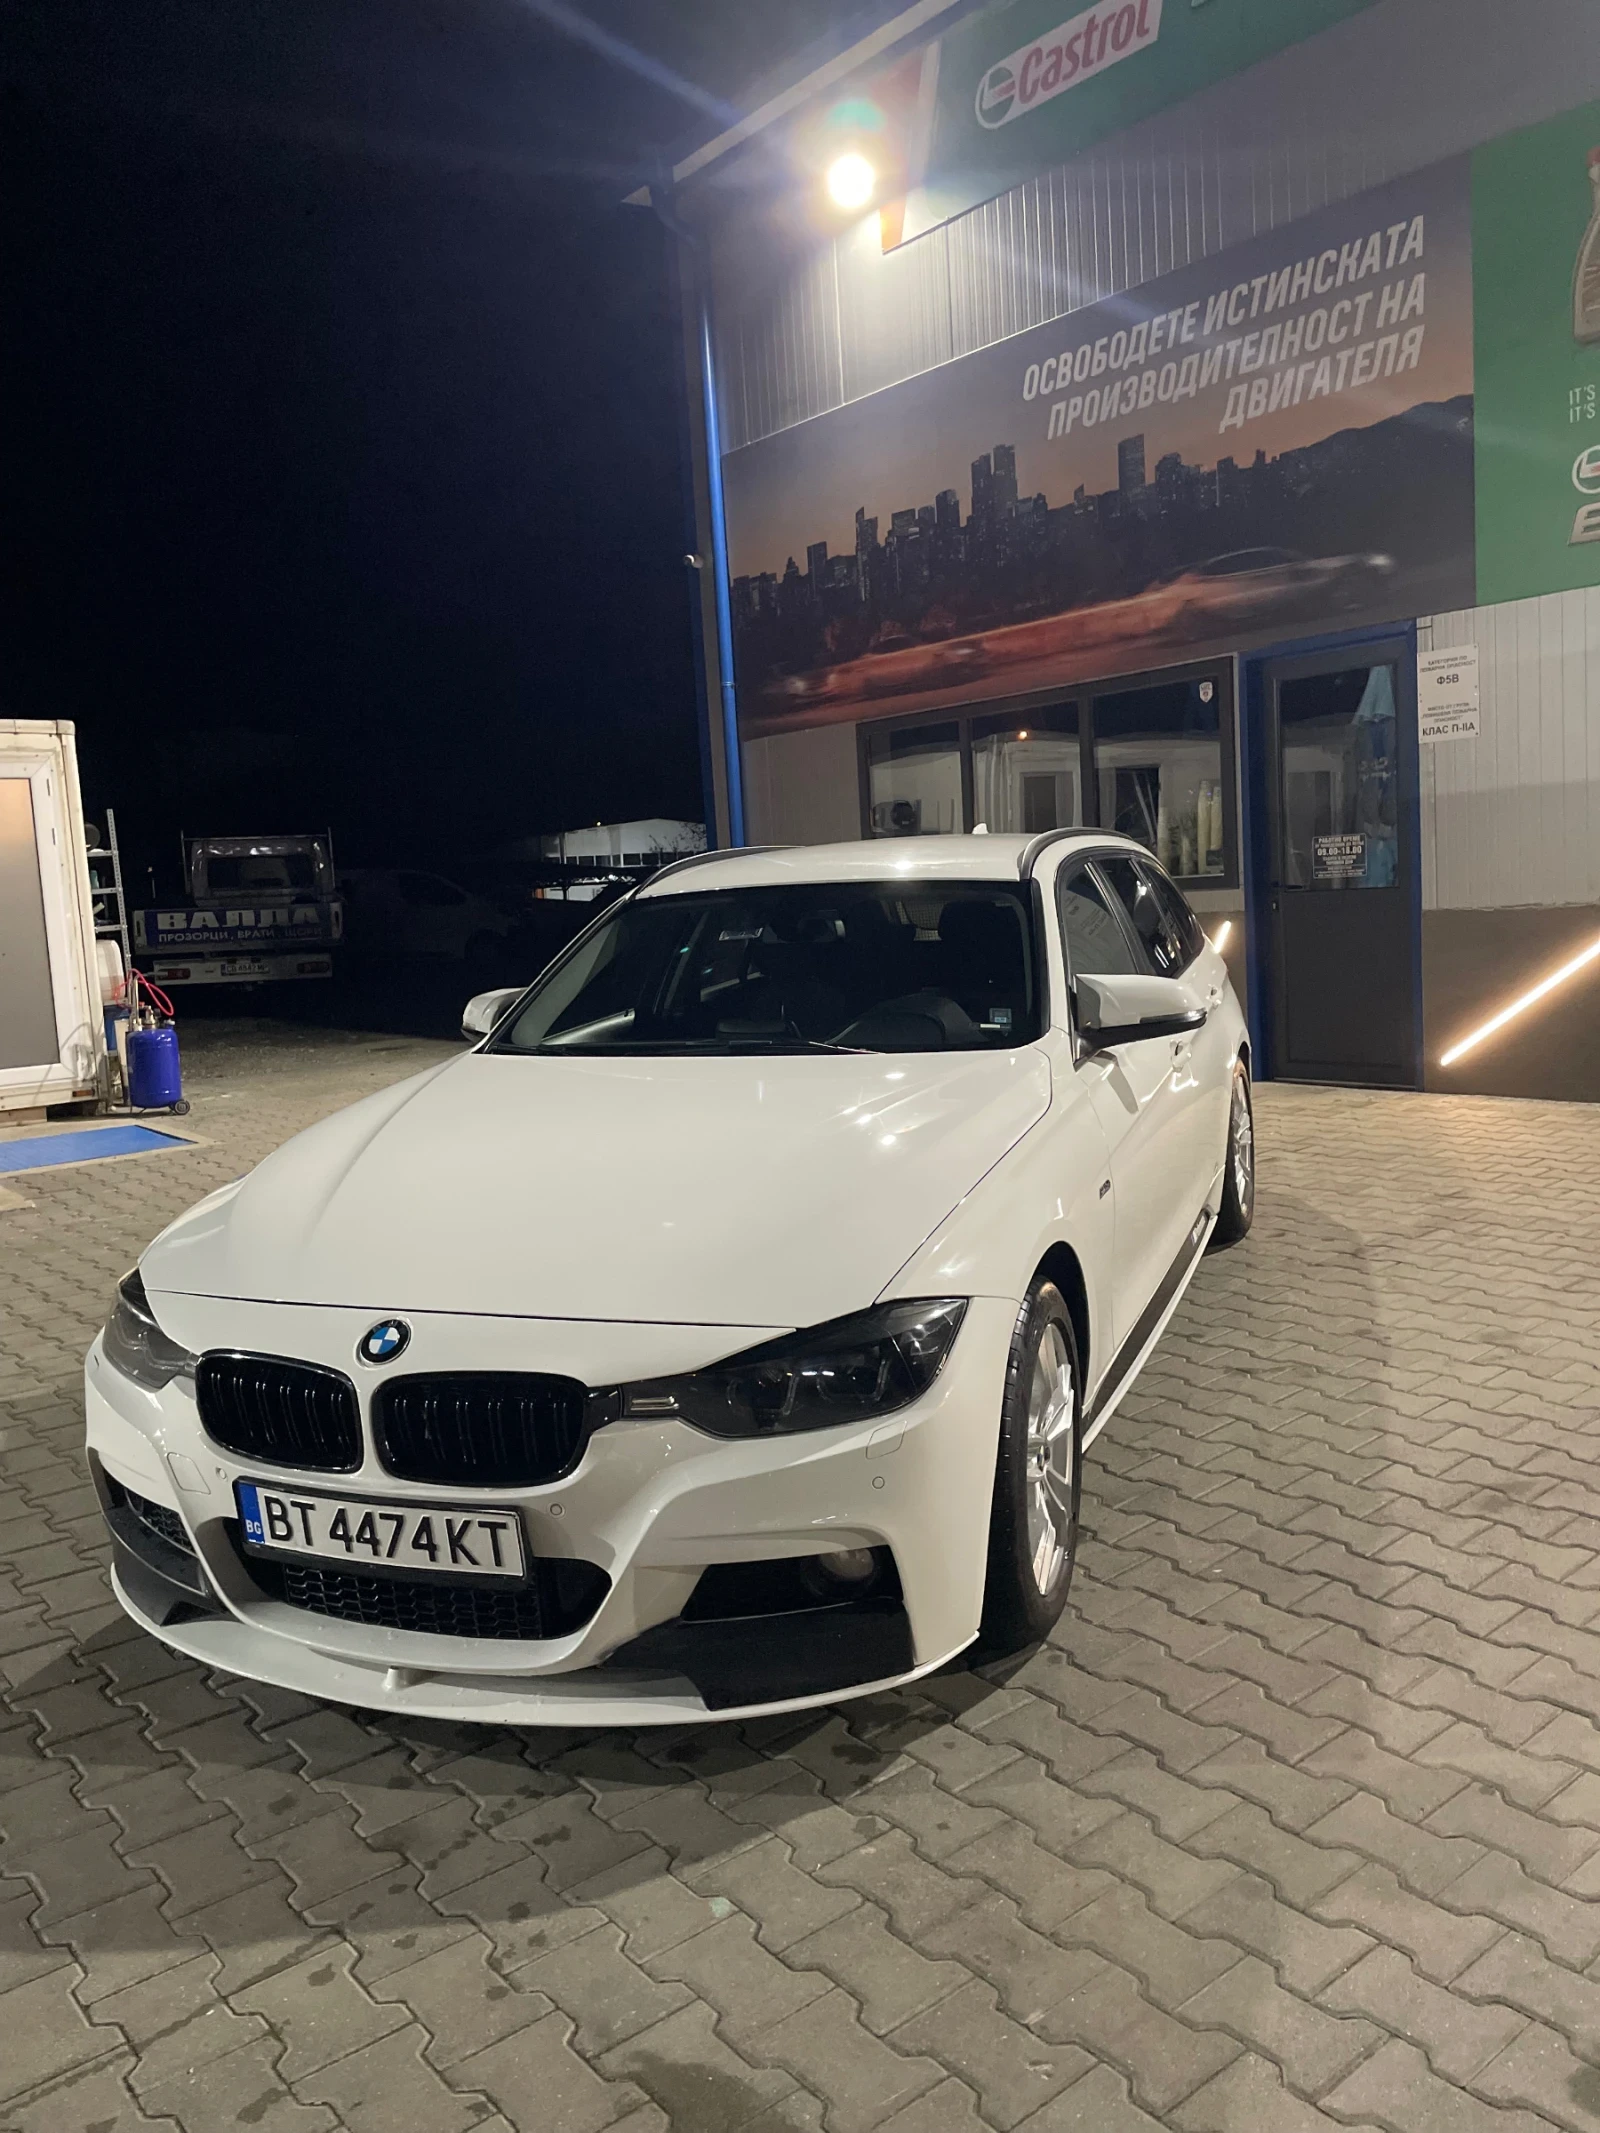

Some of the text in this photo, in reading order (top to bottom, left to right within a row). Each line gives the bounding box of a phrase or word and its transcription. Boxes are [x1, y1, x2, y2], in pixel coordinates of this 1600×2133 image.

[1018, 0, 1150, 104] Castrol
[1022, 214, 1424, 401] ОСВОБОДЕТЕ ИСТИНСКАТА
[1046, 272, 1426, 440] ПРОИЗВОДИТЕЛНОСТ НА
[1218, 324, 1425, 434] ДВИГАТЕЛЯ
[1569, 384, 1596, 406] IT'S
[1569, 402, 1596, 424] IT'S
[1422, 725, 1449, 737] КЛАС
[245, 1518, 262, 1535] BG
[263, 1494, 508, 1567] BT 4474 KT
